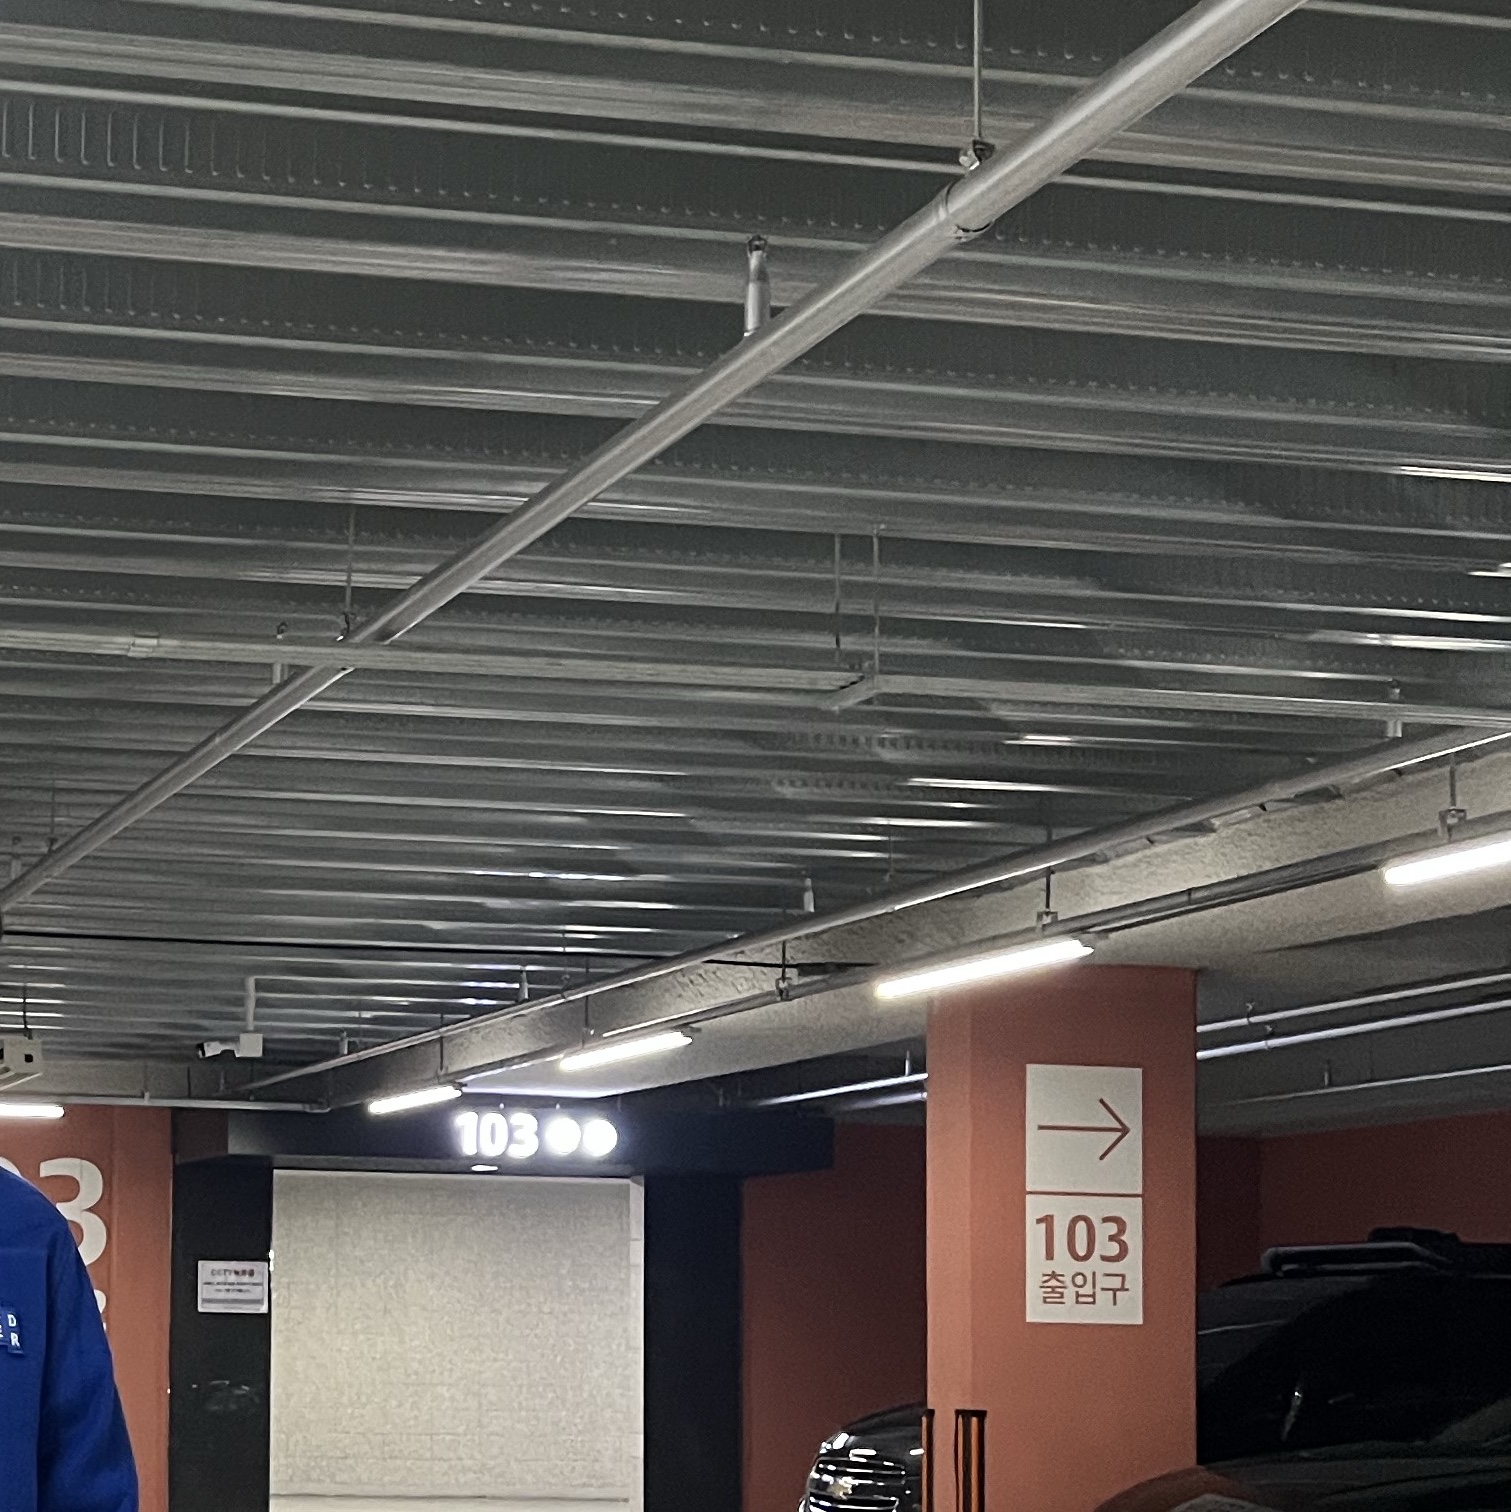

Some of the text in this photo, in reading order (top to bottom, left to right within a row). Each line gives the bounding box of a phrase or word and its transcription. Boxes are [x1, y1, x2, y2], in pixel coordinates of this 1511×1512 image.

[455, 1111, 539, 1159] 103
[1036, 1214, 1129, 1263] 103
[1039, 1270, 1129, 1306] 출입구
